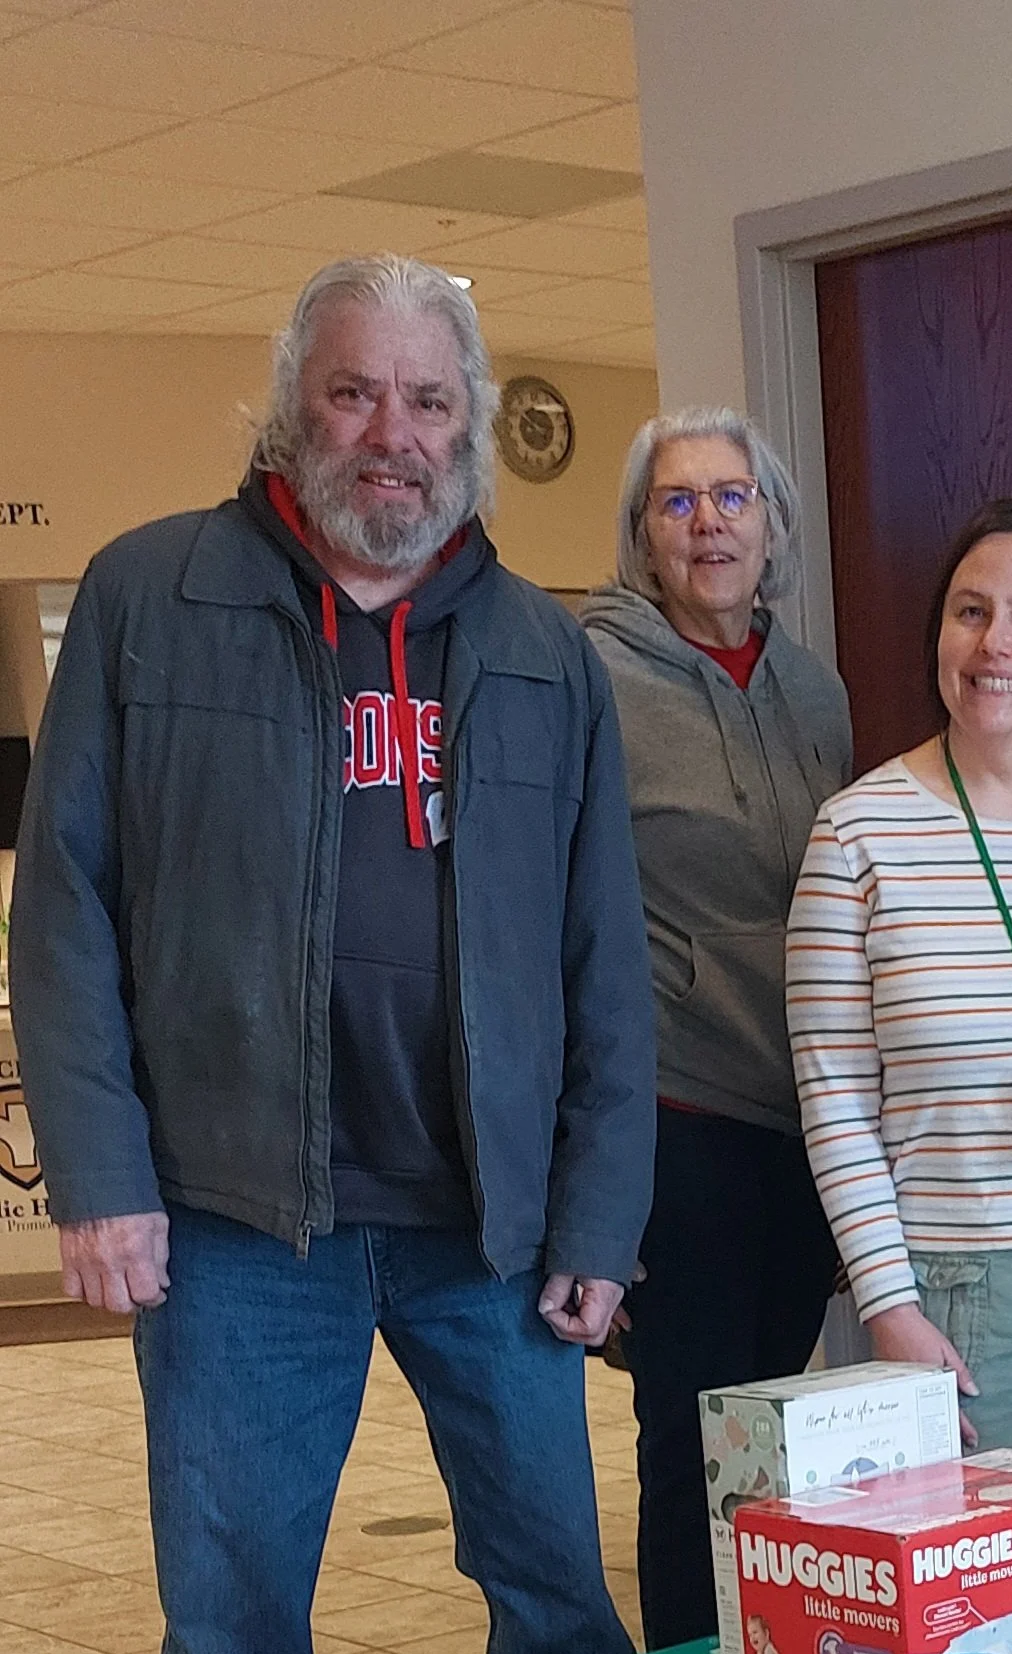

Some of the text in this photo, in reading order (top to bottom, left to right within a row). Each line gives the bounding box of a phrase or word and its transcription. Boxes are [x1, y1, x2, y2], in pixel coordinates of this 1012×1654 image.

[739, 1532, 897, 1607] HUGGIES
[961, 1571, 988, 1590] little
[804, 1595, 841, 1621] little
[844, 1605, 900, 1634] movers
